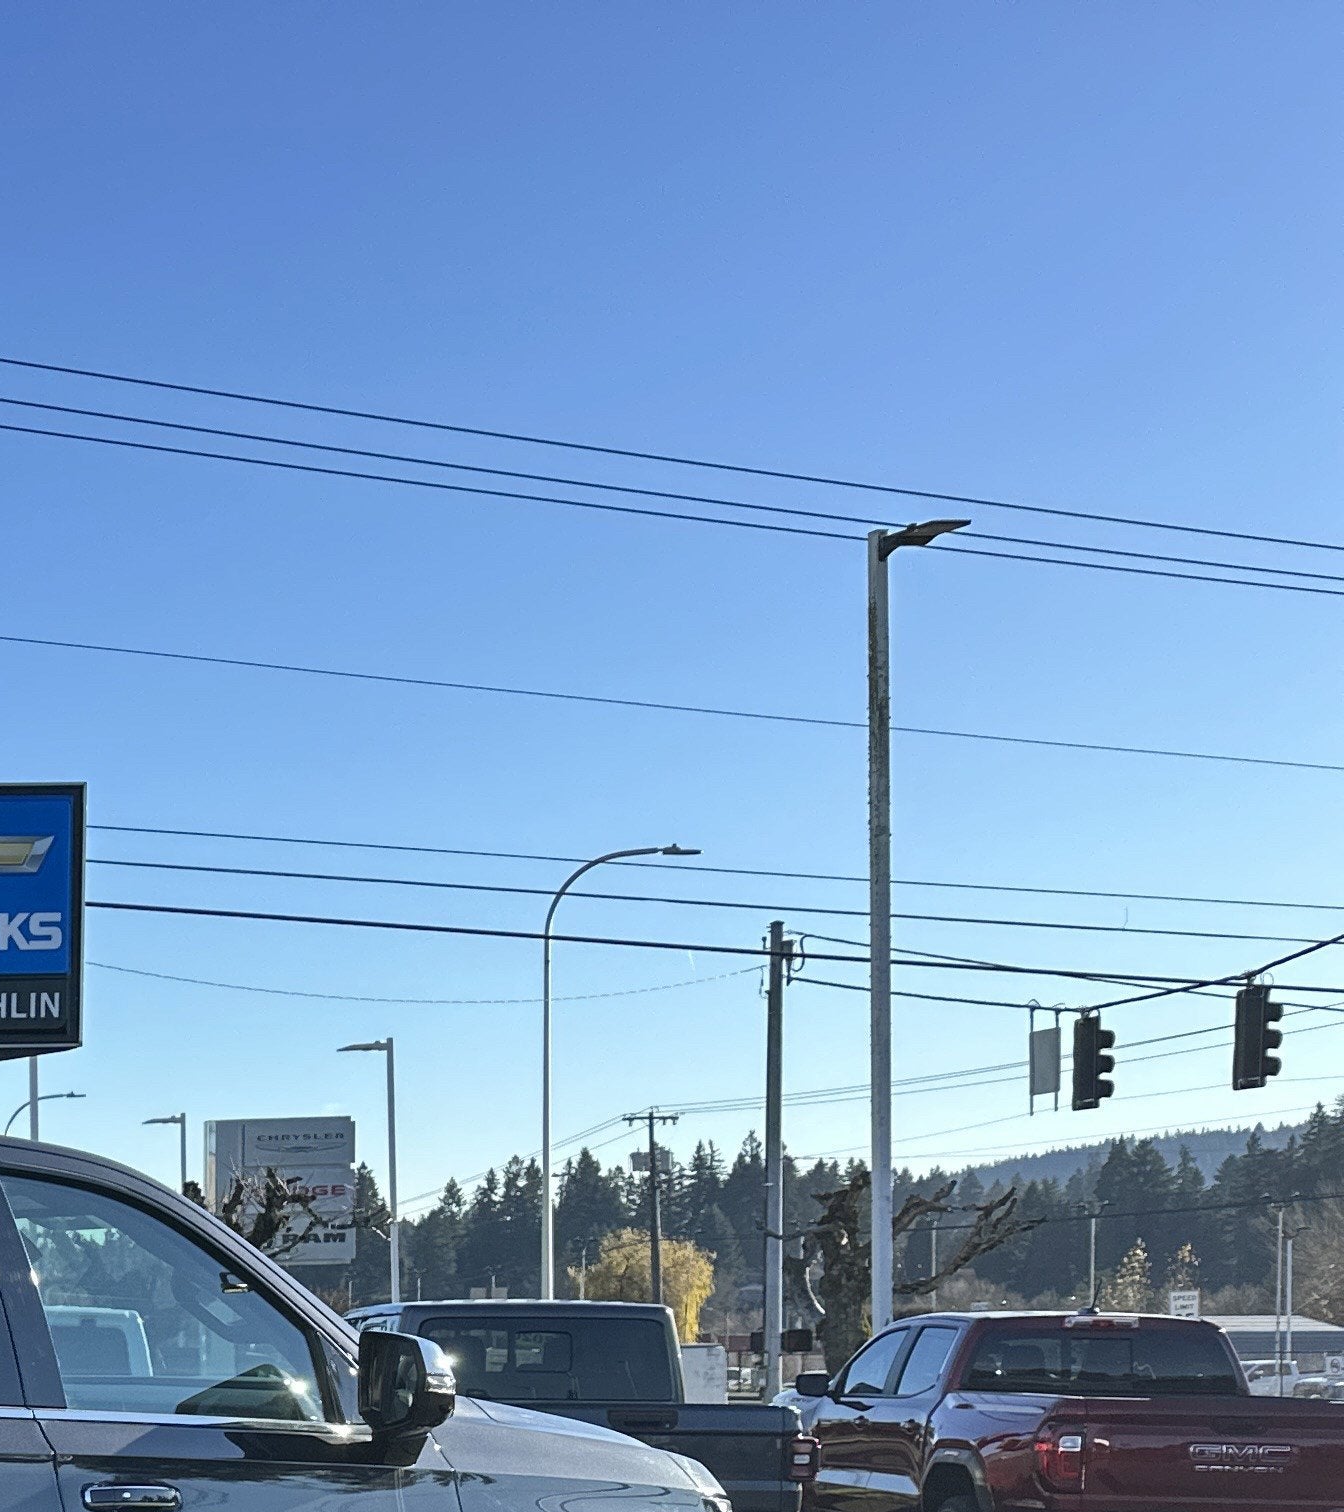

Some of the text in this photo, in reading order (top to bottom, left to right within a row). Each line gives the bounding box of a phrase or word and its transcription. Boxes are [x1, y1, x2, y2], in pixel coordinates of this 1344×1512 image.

[256, 1132, 345, 1143] CHRYSLER
[1174, 1303, 1194, 1311] LIMIT
[1189, 1443, 1291, 1463] GMC
